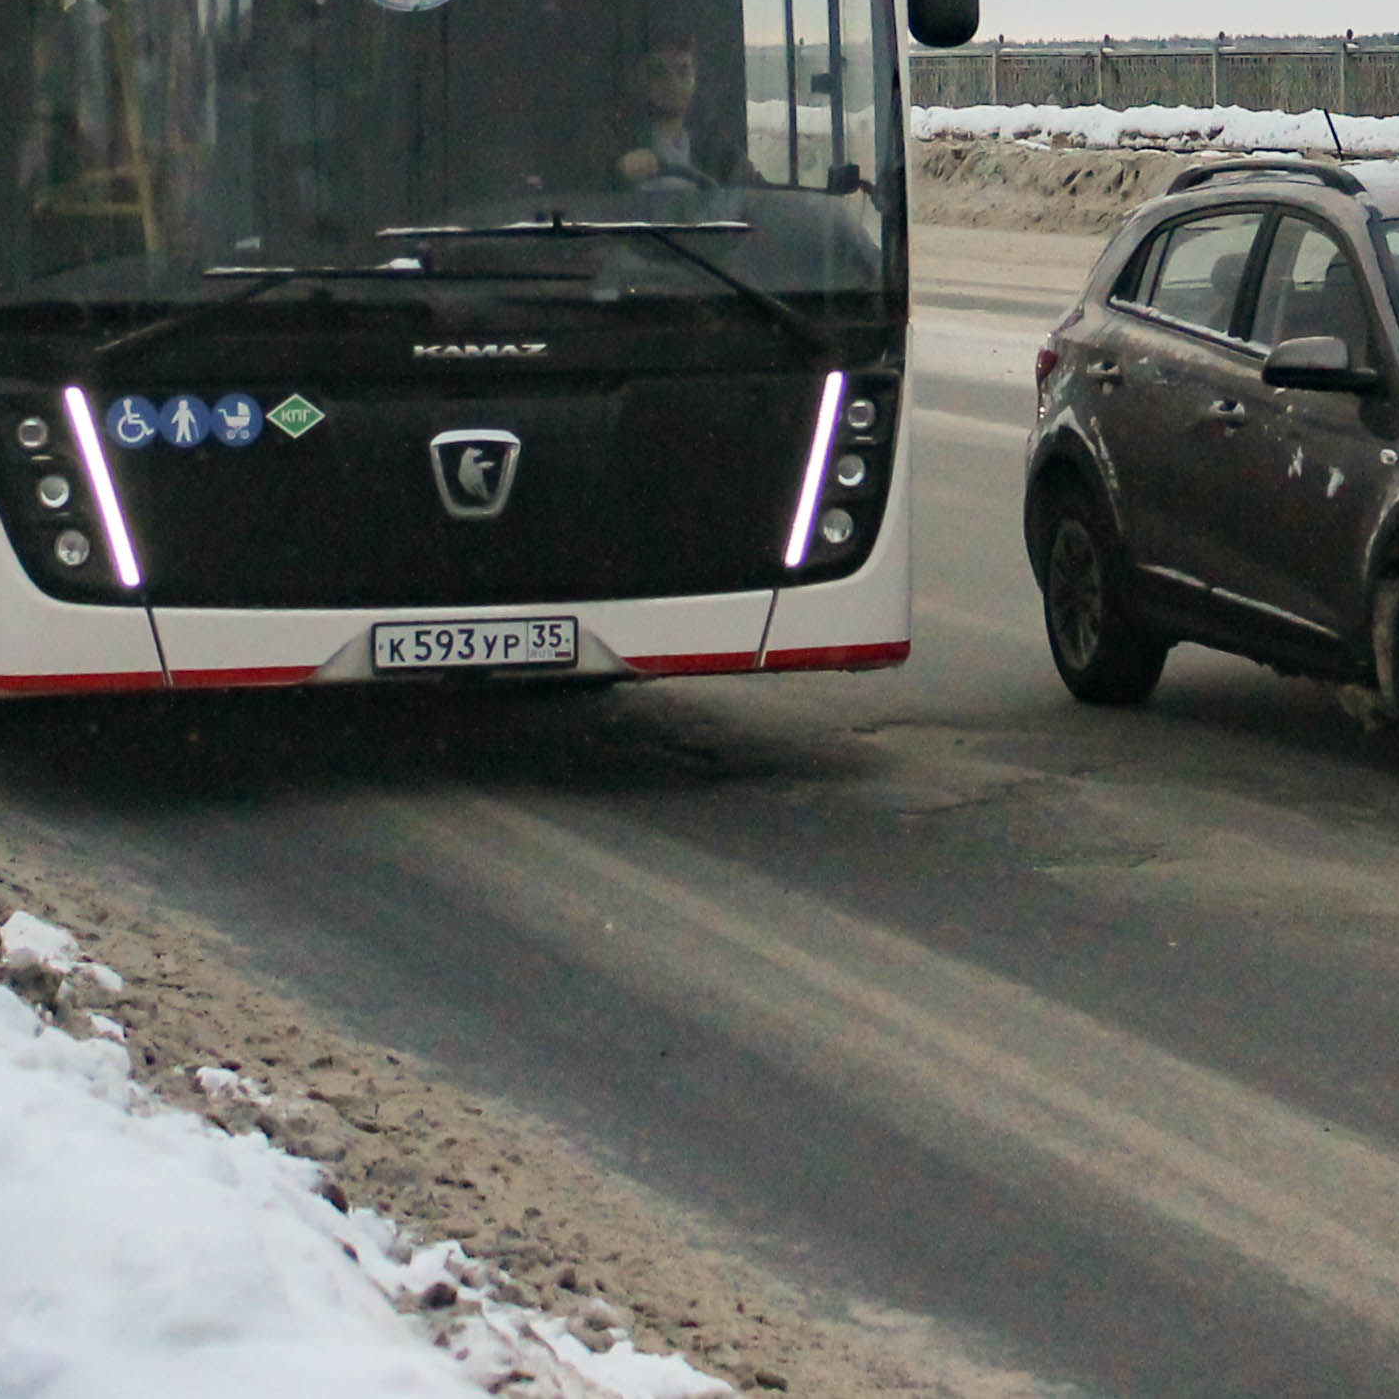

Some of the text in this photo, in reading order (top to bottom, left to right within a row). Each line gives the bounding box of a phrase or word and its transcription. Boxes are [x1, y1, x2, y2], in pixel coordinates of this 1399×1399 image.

[413, 343, 548, 358] KAMAZ
[280, 408, 311, 422] КПГ
[532, 624, 563, 648] 35
